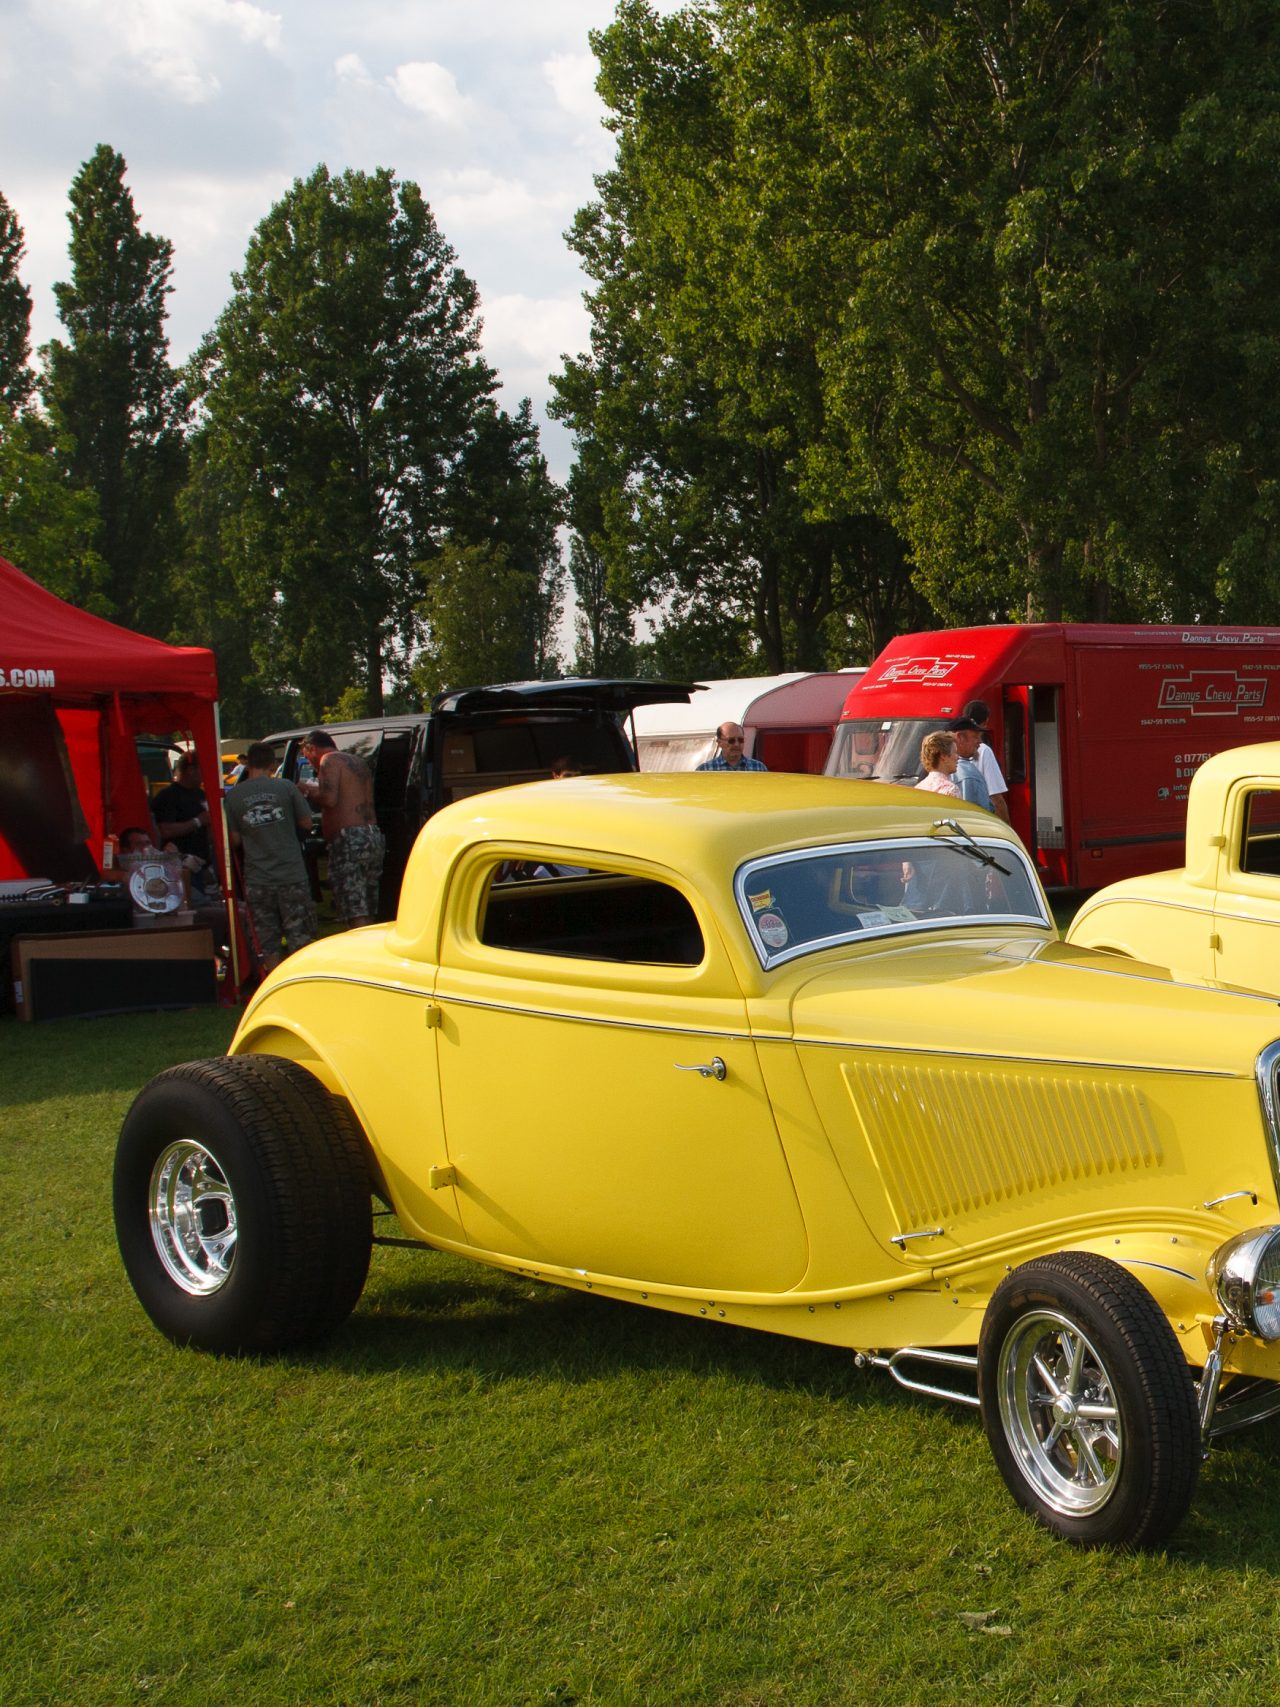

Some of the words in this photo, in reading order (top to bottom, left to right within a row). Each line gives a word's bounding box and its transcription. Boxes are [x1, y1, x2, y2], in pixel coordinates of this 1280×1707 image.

[1181, 632, 1211, 643] Dannys
[1215, 632, 1239, 644] Chevy
[1242, 632, 1265, 643] Parts
[1166, 685, 1200, 700] Dannys
[1205, 684, 1232, 701] Chevy
[1236, 684, 1262, 700] Parts
